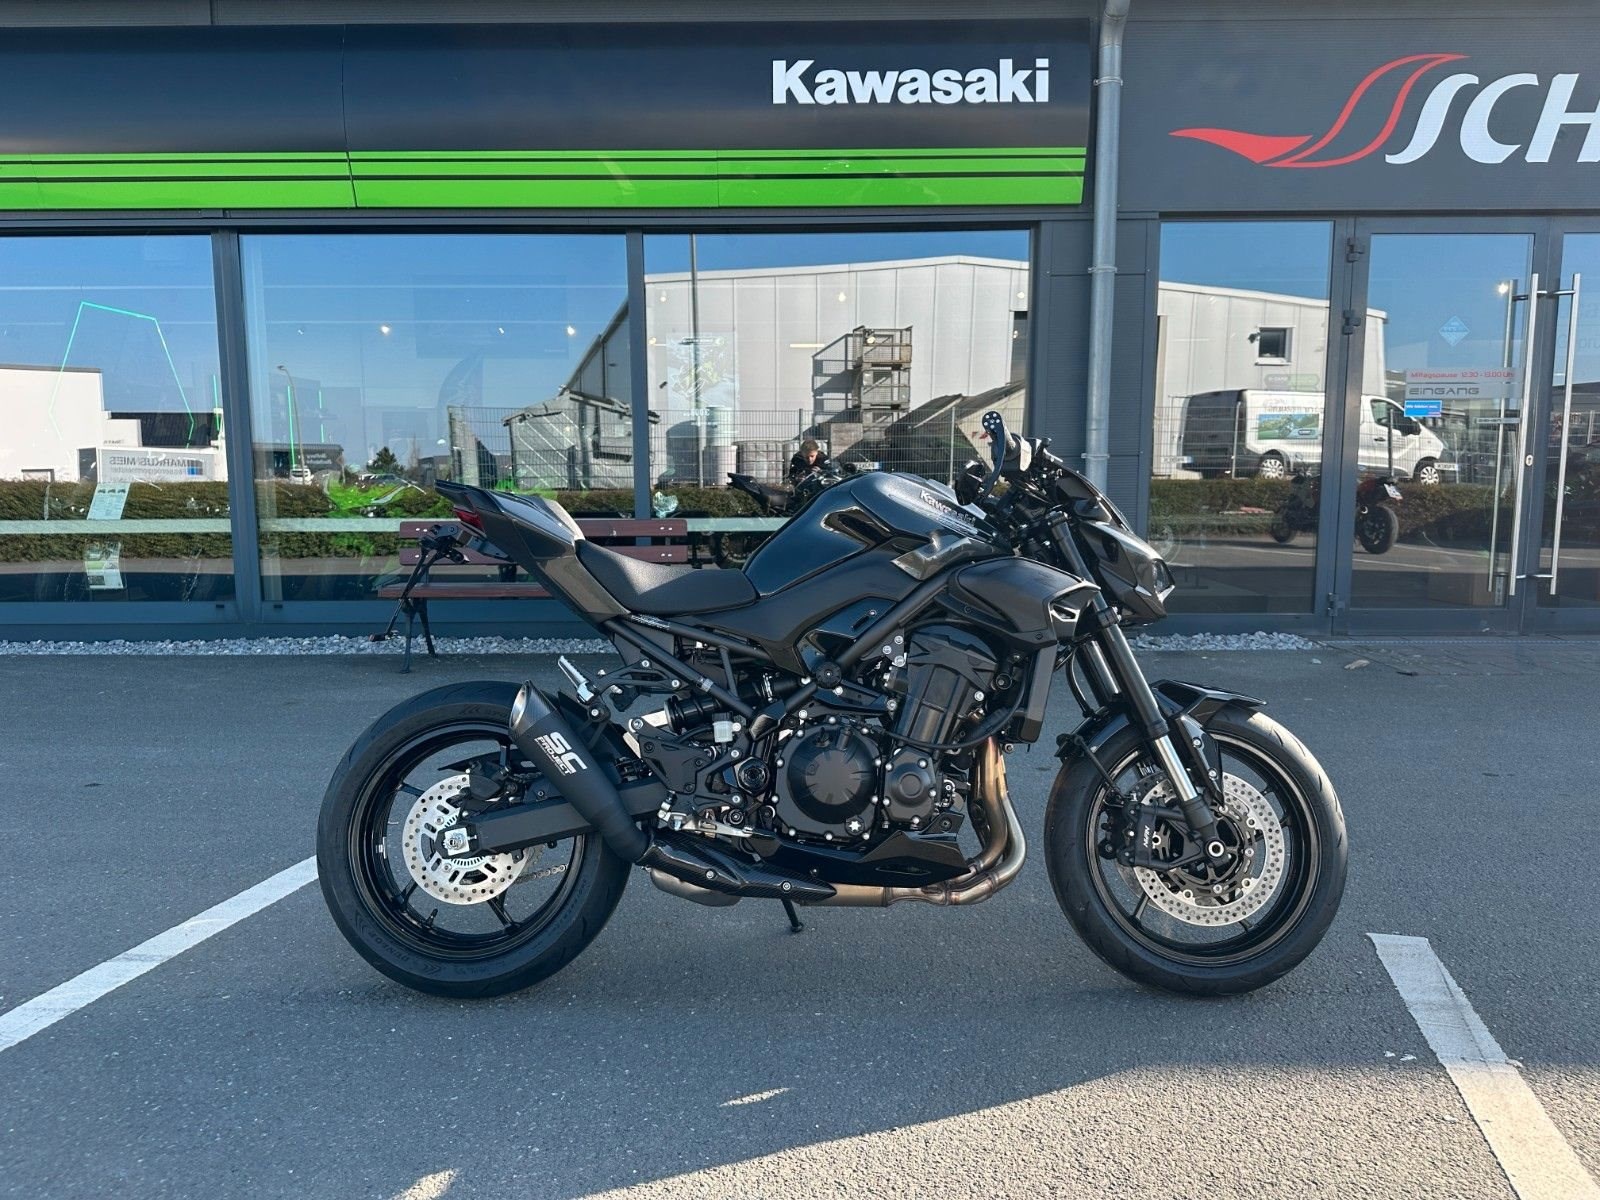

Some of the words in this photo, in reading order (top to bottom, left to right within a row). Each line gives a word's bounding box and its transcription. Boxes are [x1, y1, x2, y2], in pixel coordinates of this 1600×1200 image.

[772, 58, 1049, 105] Kawasaki
[1410, 371, 1458, 379] Mittagspause
[536, 736, 573, 775] PROJECT
[541, 731, 588, 774] SC
